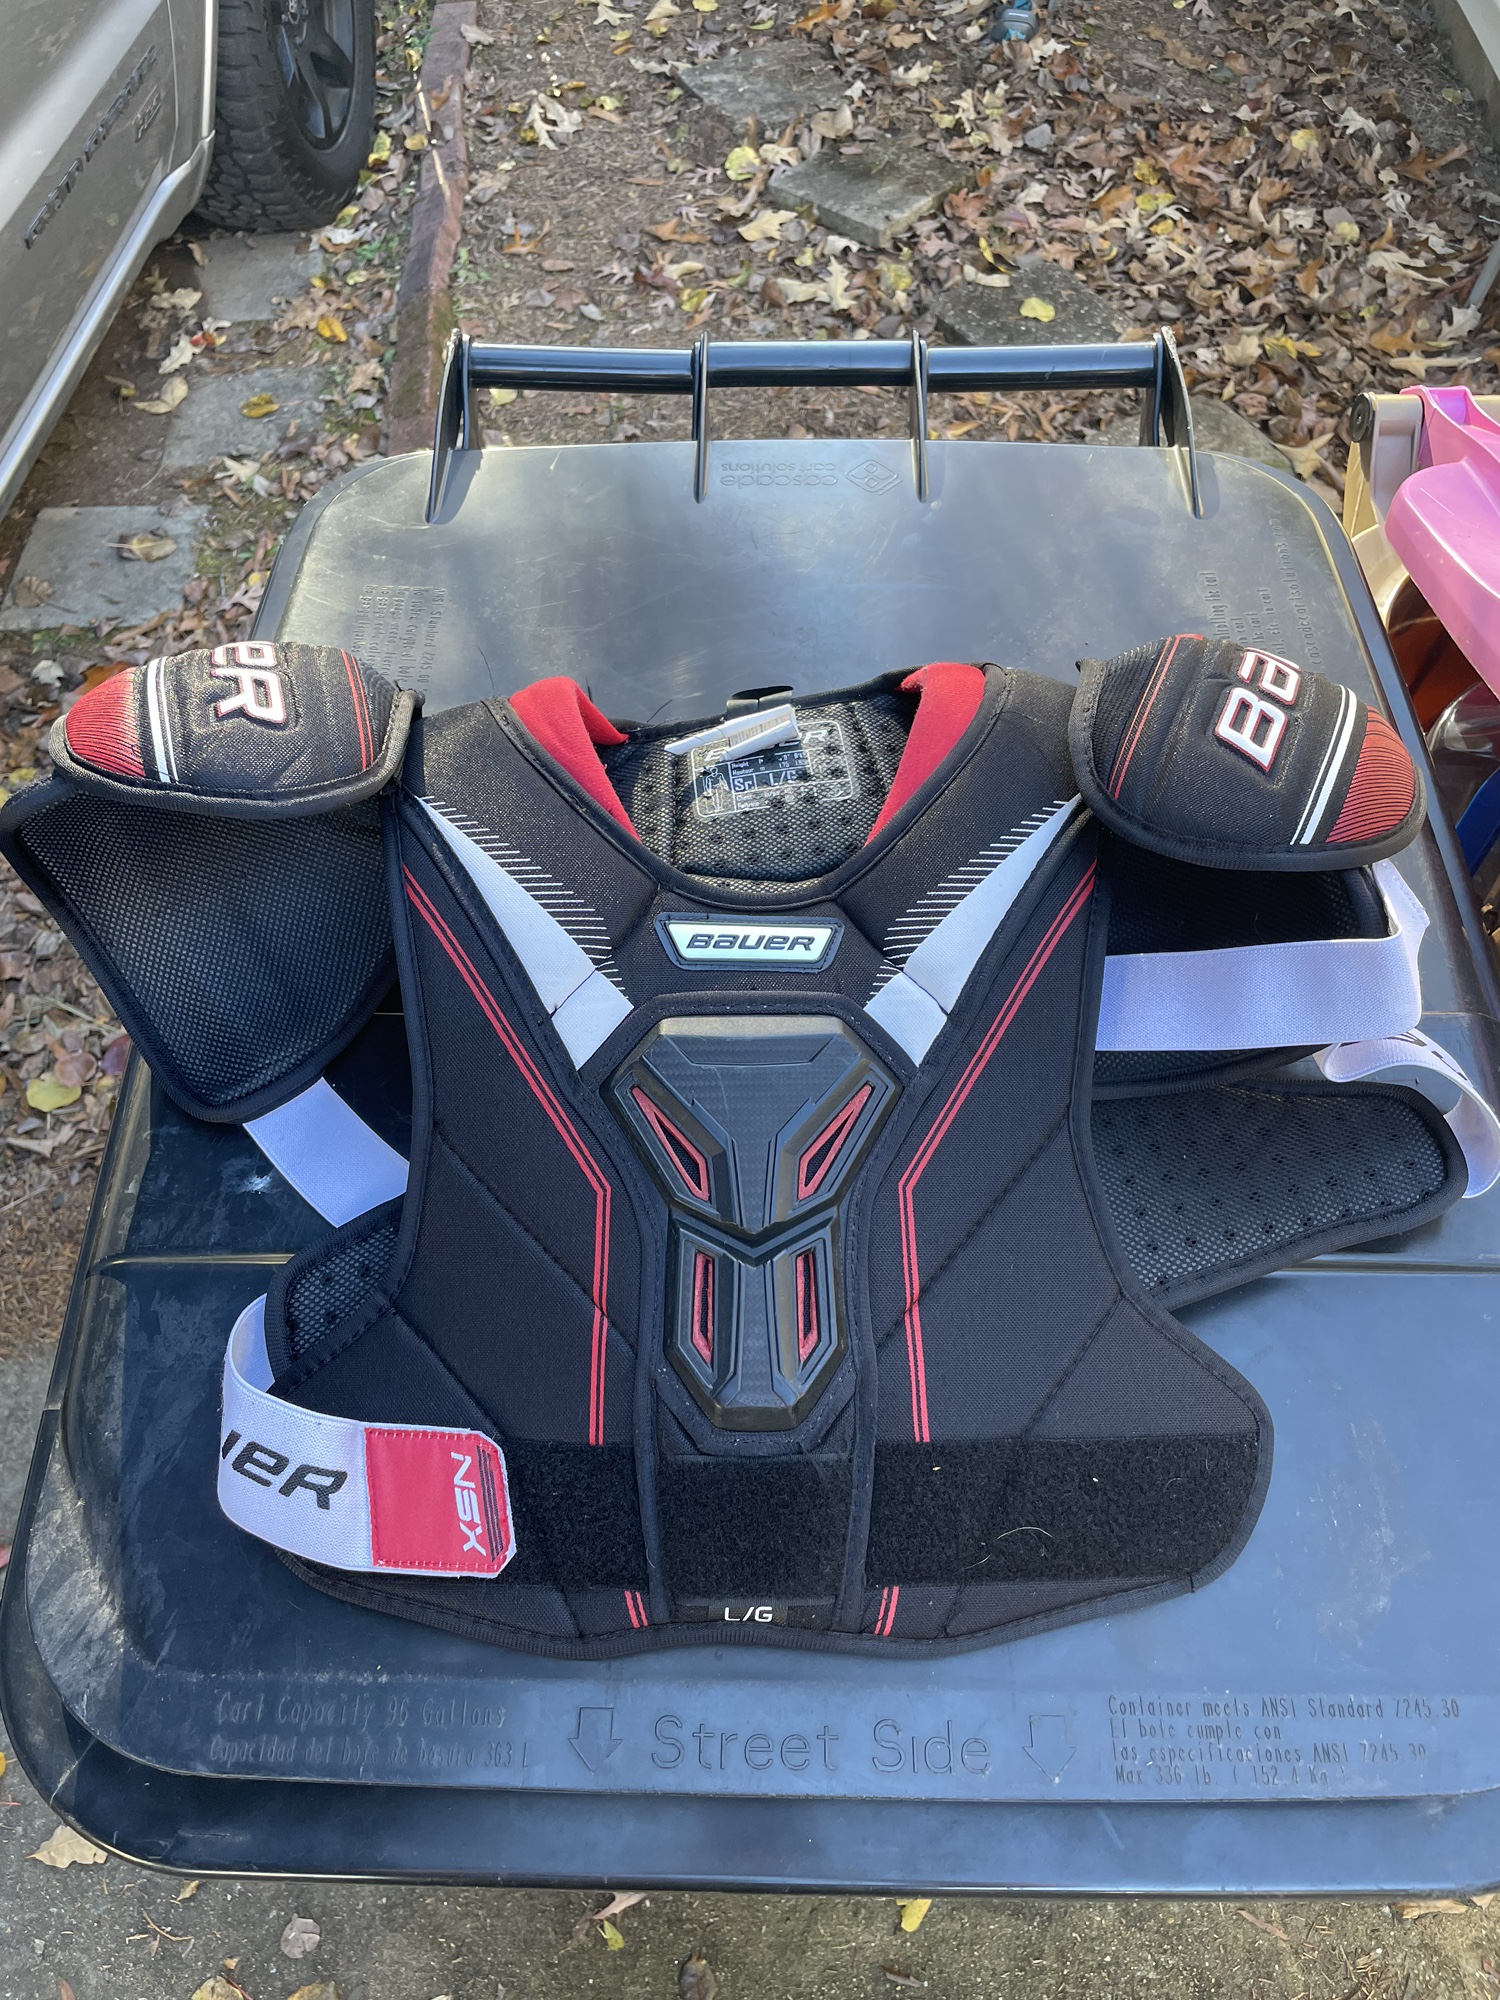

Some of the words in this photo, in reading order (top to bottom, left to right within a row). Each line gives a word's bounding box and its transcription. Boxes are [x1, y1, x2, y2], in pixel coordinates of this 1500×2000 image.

[721, 462, 794, 475] solutions
[799, 463, 836, 473] cart
[720, 475, 838, 489] cascade
[450, 1451, 487, 1557] NSX
[724, 1606, 773, 1623] L/G
[421, 1696, 507, 1728] Gallons
[1261, 1698, 1297, 1719] ANSI
[1308, 1699, 1384, 1719] Standard
[1254, 1724, 1282, 1740] con
[650, 1714, 839, 1770] Street
[871, 1718, 992, 1774] Side
[1112, 1740, 1139, 1762] las
[1313, 1743, 1350, 1764] ANSI
[1115, 1765, 1144, 1786] Max
